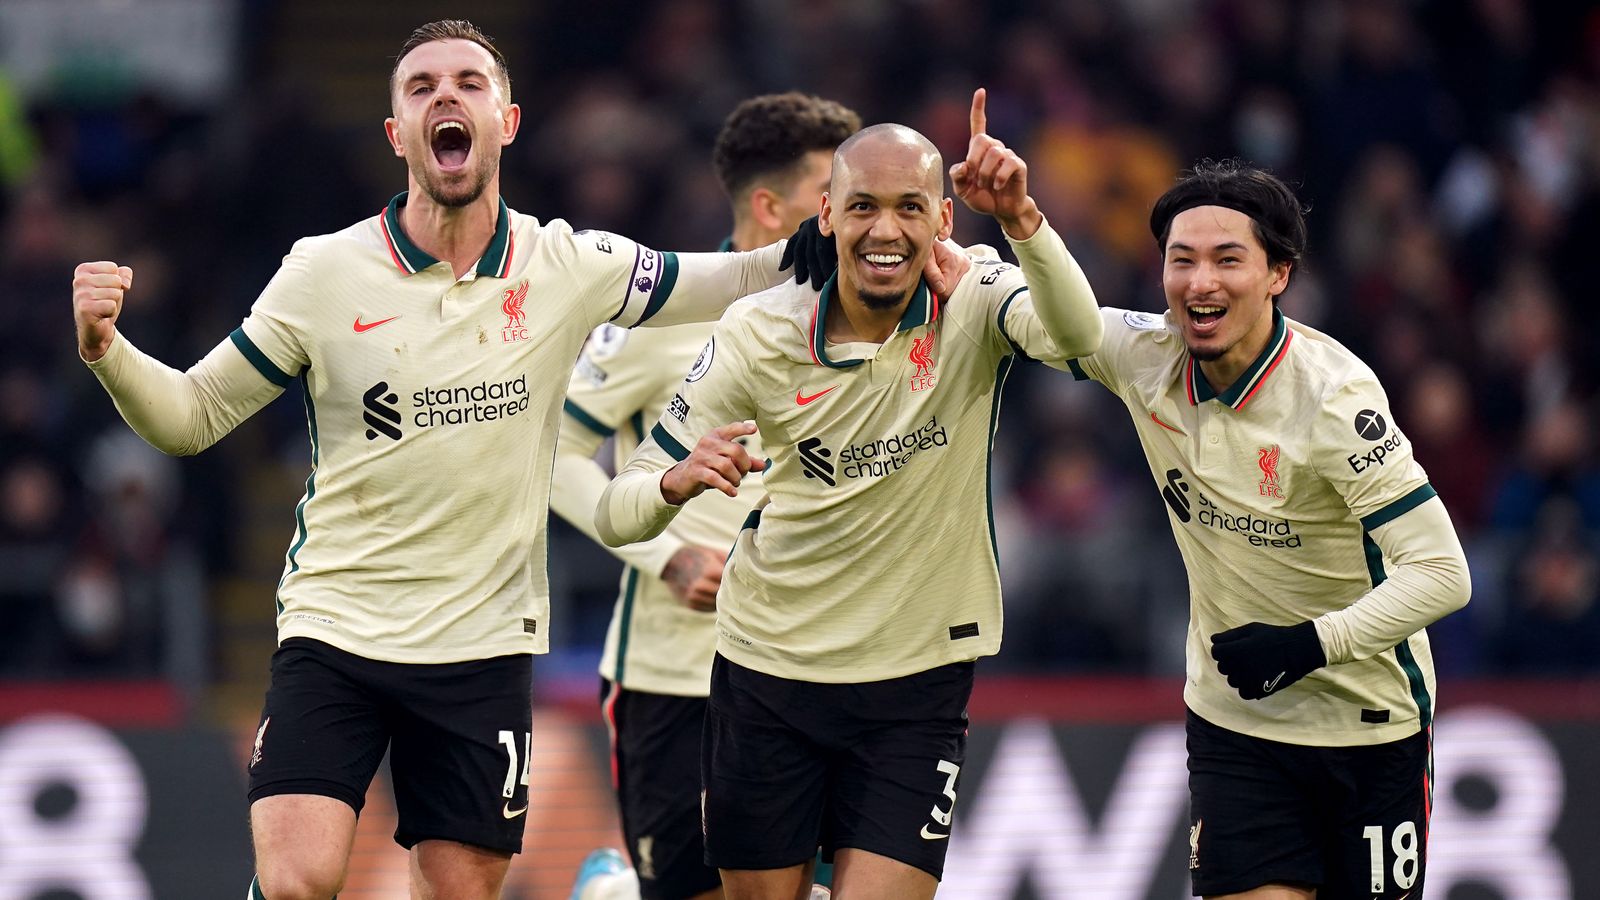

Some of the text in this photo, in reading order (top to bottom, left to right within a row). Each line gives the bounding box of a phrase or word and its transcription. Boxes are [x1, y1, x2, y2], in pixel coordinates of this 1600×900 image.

[413, 374, 527, 408] standard
[414, 393, 529, 428] chartered
[840, 416, 936, 463] standard
[844, 427, 948, 479] chartered
[1347, 427, 1402, 474] Exped
[931, 759, 960, 826] 3
[1363, 820, 1418, 893] 18
